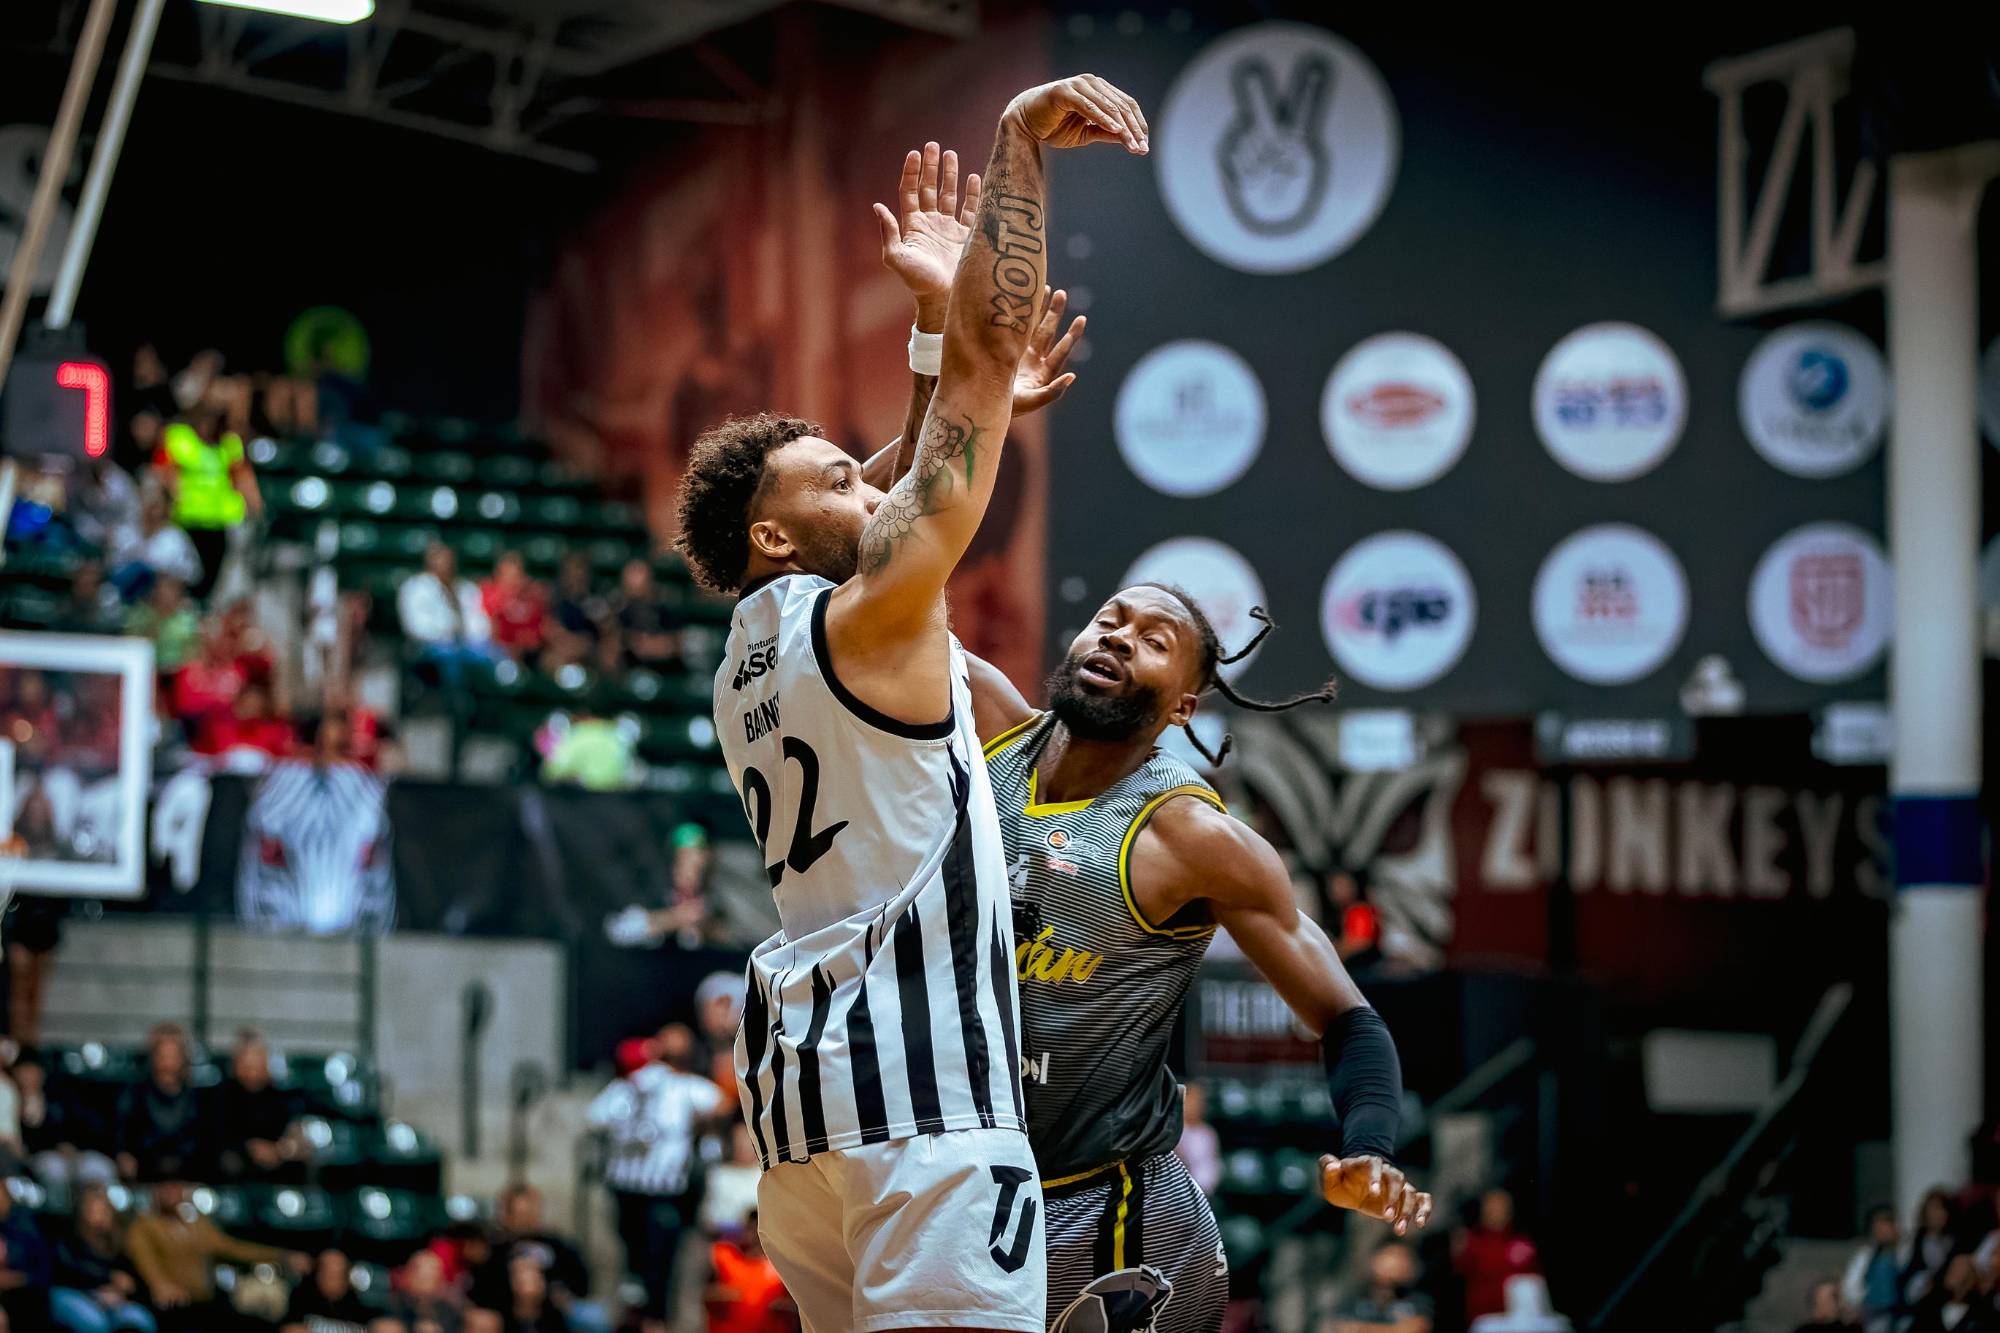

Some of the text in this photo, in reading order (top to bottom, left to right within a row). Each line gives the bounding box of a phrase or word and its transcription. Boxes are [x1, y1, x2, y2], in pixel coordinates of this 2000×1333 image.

[56, 361, 109, 458] 7
[747, 633, 778, 652] Pinturas
[742, 736, 849, 889] 22
